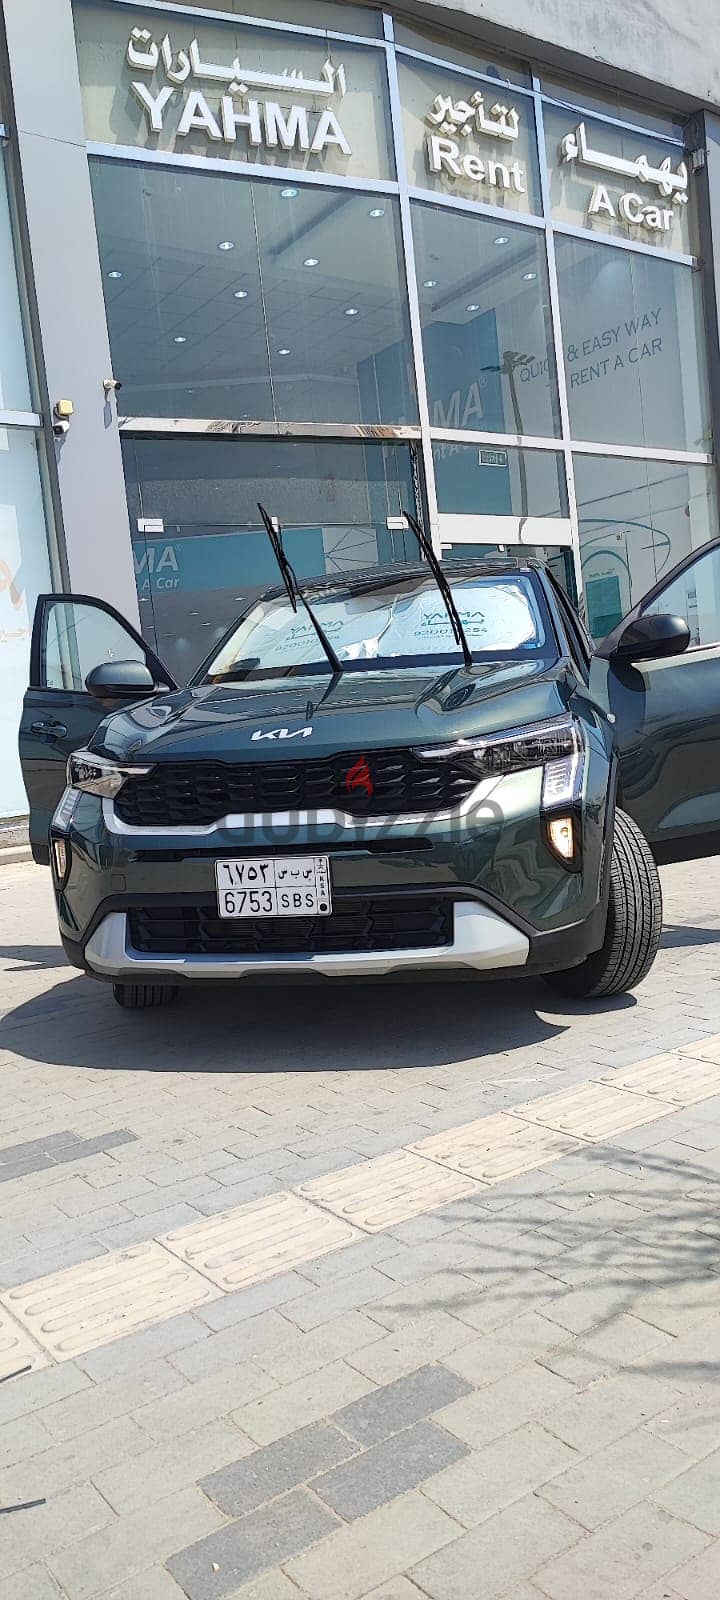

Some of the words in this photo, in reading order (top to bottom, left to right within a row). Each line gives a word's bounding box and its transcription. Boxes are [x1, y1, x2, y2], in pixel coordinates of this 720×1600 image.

[126, 26, 347, 98] السيارات
[130, 80, 352, 155] YAHMA
[425, 90, 520, 142] لتأجير
[427, 134, 526, 193] Rent
[560, 121, 689, 204] يهماء
[587, 183, 616, 218] A
[619, 192, 674, 232] Car
[582, 325, 621, 356] EASY
[624, 307, 662, 337] WAY
[569, 358, 610, 388] RENT
[613, 355, 625, 371] A
[627, 337, 663, 363] CAR
[156, 577, 181, 589] Car
[224, 890, 273, 913] 6753
[281, 893, 314, 908] SBS
